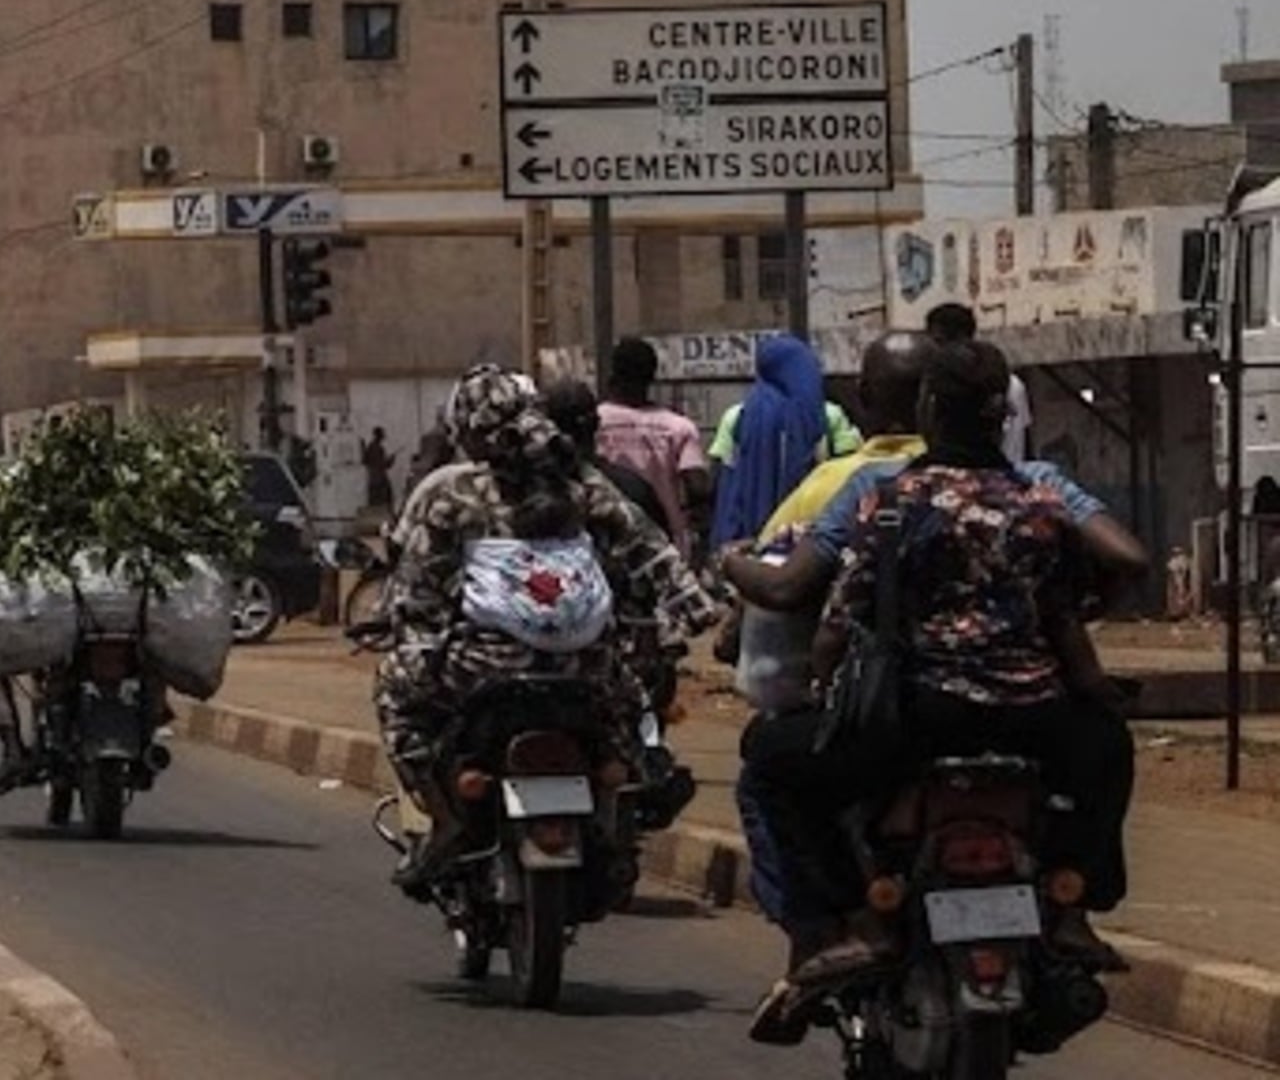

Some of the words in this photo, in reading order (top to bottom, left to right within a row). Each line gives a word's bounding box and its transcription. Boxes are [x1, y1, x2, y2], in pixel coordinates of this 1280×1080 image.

[648, 17, 877, 49] CENTRE-VILLE
[612, 53, 880, 84] BACODJICORONI
[726, 113, 883, 143] SIRAKORO
[554, 151, 742, 182] LOGEMENTS
[750, 149, 883, 178] SOCIAUX
[682, 332, 764, 362] DEN
